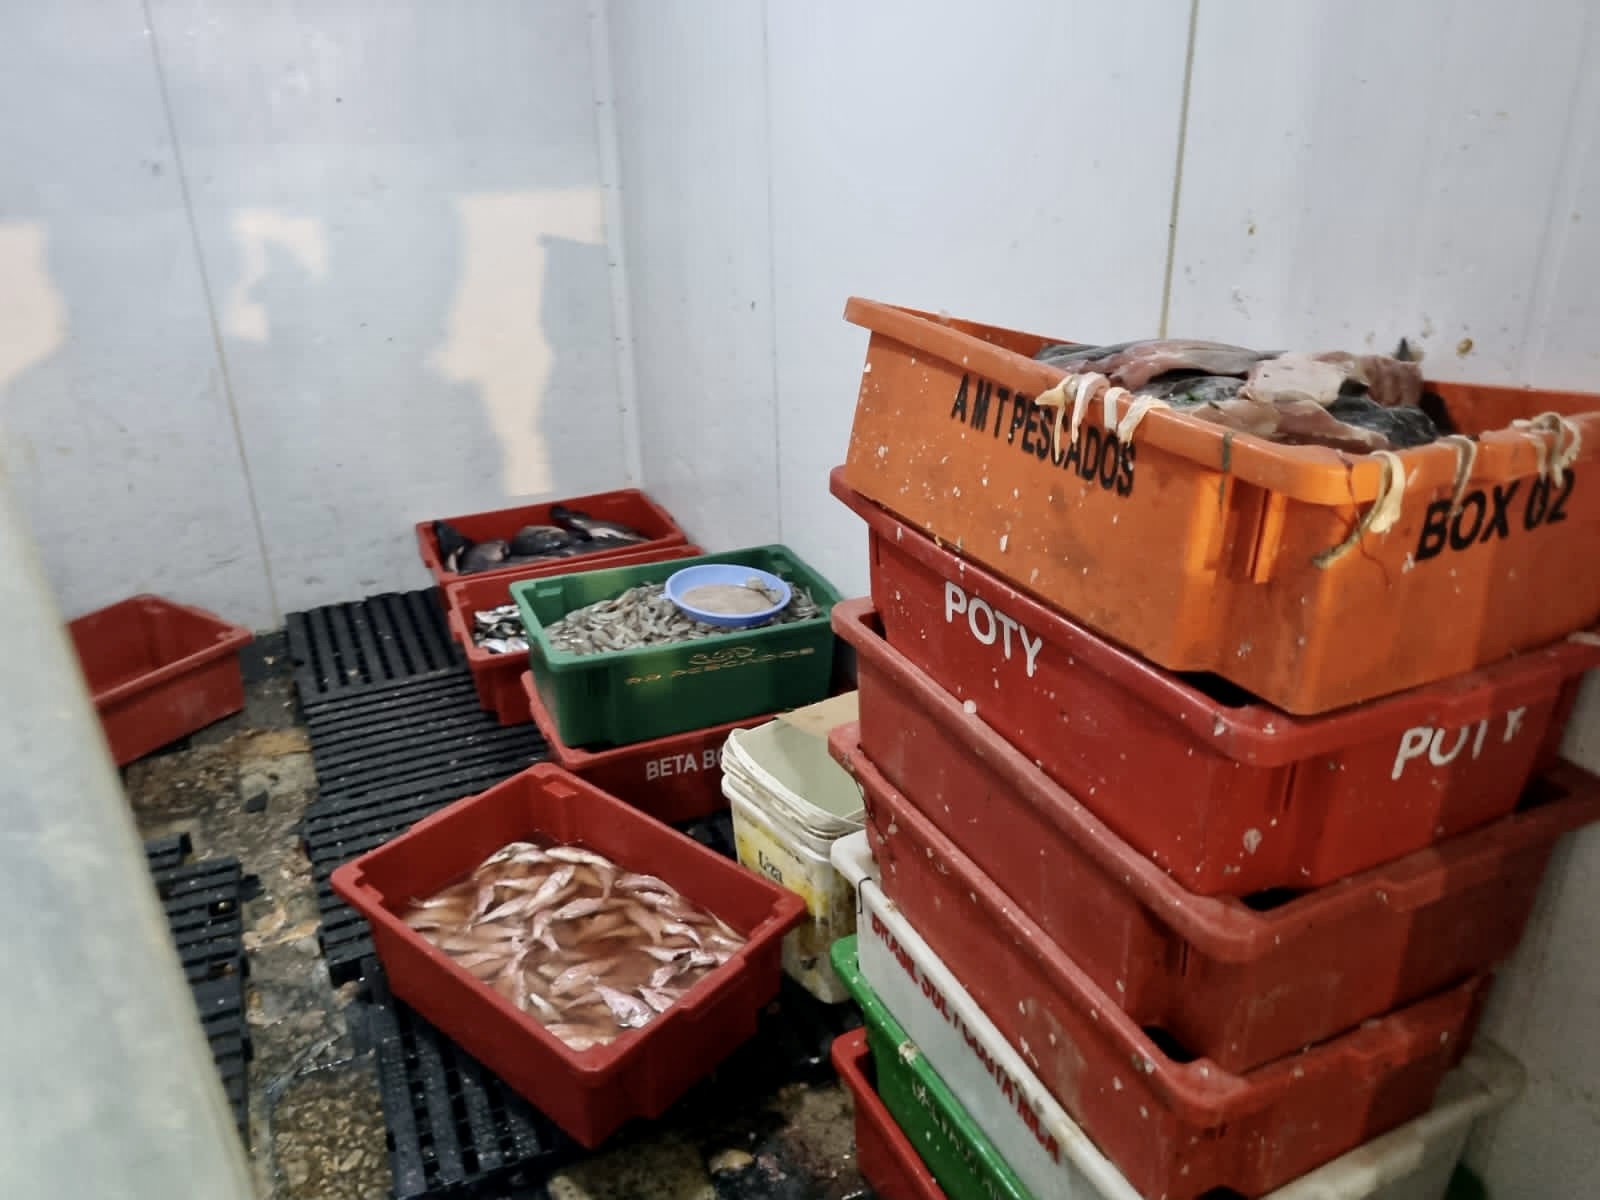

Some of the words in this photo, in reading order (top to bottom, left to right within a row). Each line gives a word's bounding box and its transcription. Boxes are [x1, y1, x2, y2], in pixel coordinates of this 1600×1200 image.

[1414, 479, 1520, 562] BOX
[1523, 467, 1575, 531] 02
[945, 581, 1043, 678] POTY
[646, 753, 698, 781] BETA
